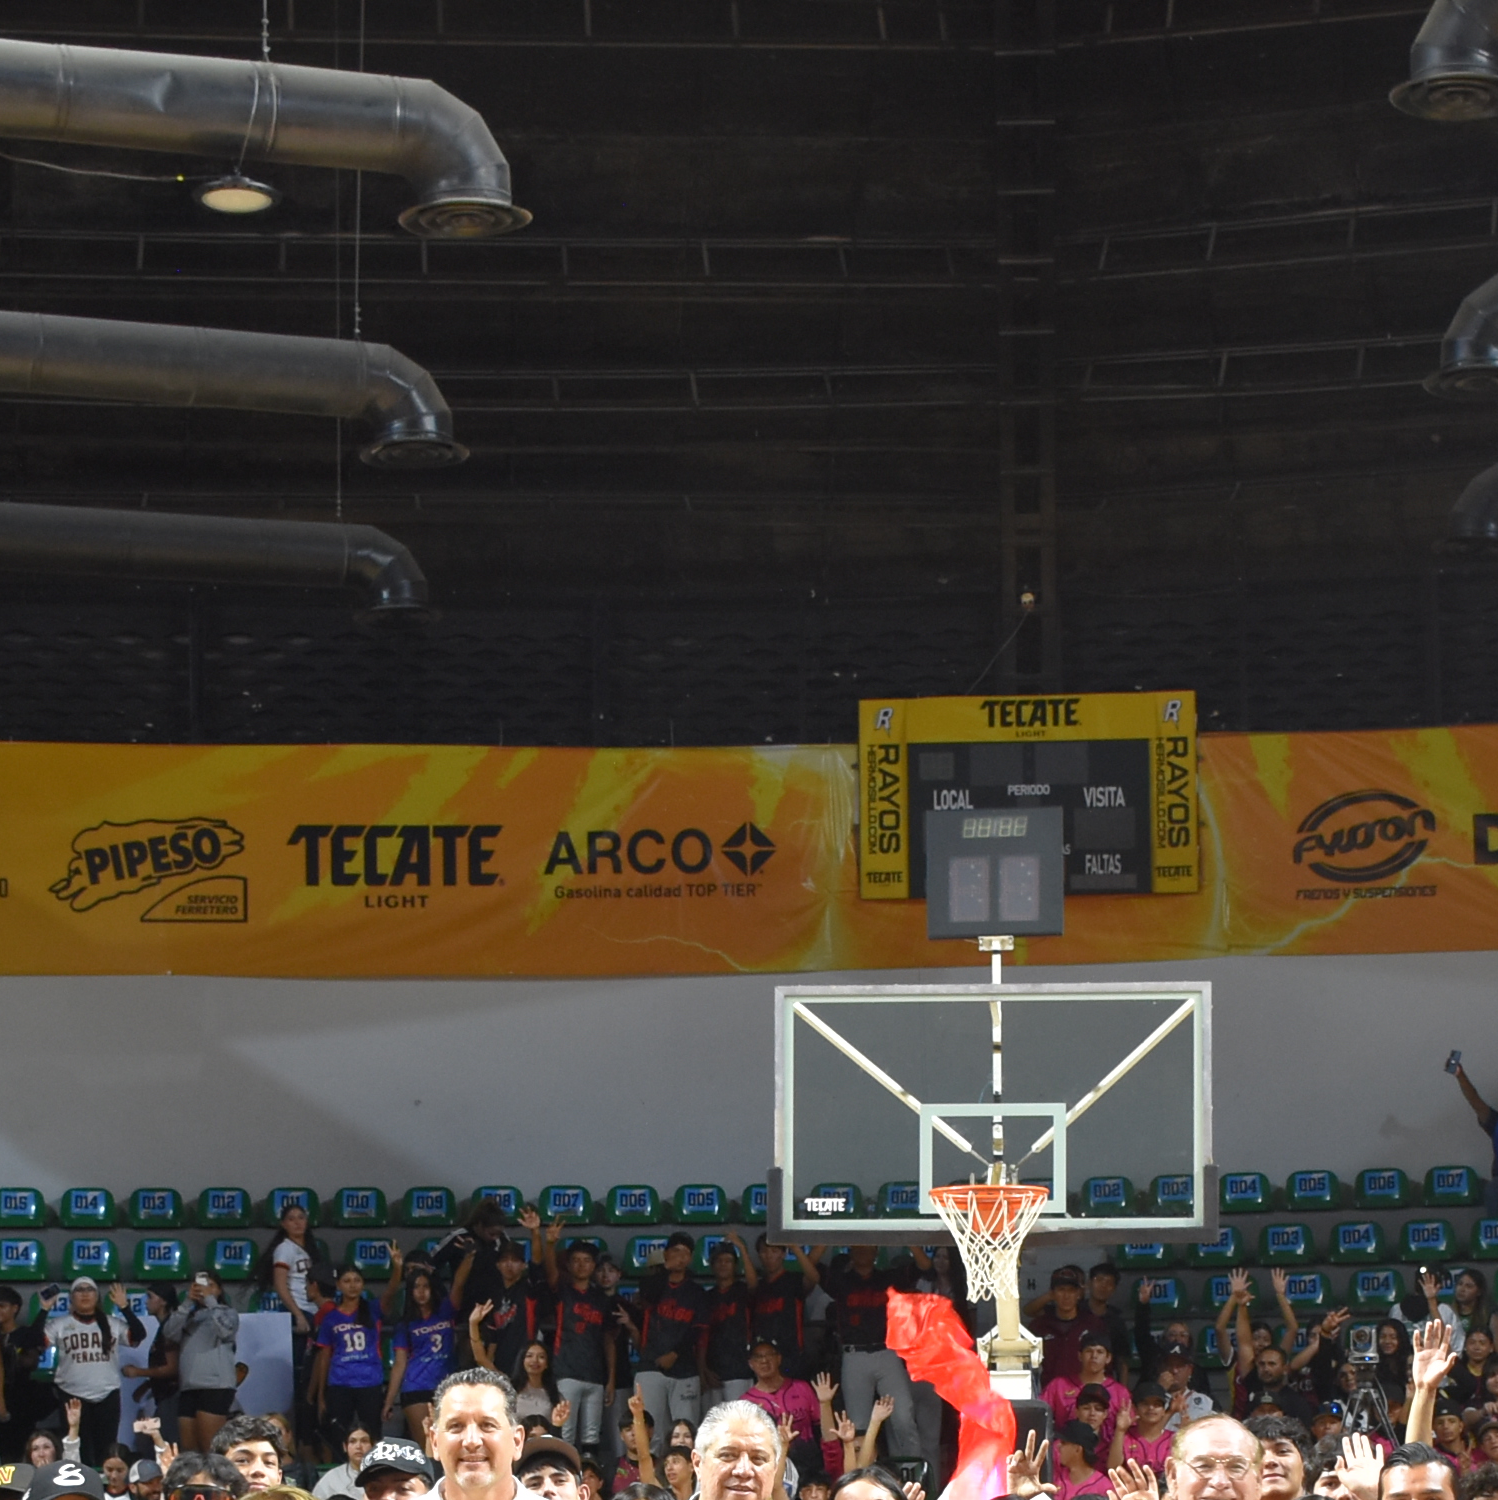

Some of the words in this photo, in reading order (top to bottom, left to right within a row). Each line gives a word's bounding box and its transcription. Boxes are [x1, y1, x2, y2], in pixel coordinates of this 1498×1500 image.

[981, 699, 1080, 727] TECATE
[1008, 784, 1050, 796] PERIODO
[1083, 787, 1125, 808] VISITA
[1166, 736, 1188, 849] RAYOS
[878, 744, 899, 854] RAYOS
[933, 790, 973, 810] LOCAL
[84, 827, 221, 886] PIPESO
[287, 824, 503, 887] TECATE
[544, 828, 712, 875] ARCO
[1086, 854, 1121, 874] FALTAS
[1156, 865, 1192, 877] TECATE
[866, 871, 903, 883] TECATE
[554, 885, 621, 899] Gasolina
[626, 885, 681, 898] calidad
[686, 884, 717, 897] TOP
[187, 895, 238, 905] SERVICIO
[364, 894, 429, 909] LIGHT
[175, 906, 238, 915] FERRETERO
[1230, 1180, 1257, 1194] 004
[1298, 1177, 1326, 1191] 005
[1369, 1175, 1395, 1190] 006
[1437, 1173, 1463, 1187] 007
[891, 1187, 918, 1202] 002
[1094, 1184, 1120, 1198] 002
[1162, 1182, 1189, 1196] 003
[4, 1195, 29, 1210] 015
[74, 1195, 99, 1210] 014
[143, 1195, 166, 1211] 013
[211, 1195, 235, 1210] 012
[346, 1195, 369, 1209] 010
[416, 1195, 443, 1210] 009
[553, 1194, 579, 1208] 007
[620, 1193, 647, 1208] 006
[687, 1193, 714, 1207] 005
[804, 1198, 846, 1212] TECATE
[1271, 1231, 1299, 1246] 003
[1342, 1229, 1370, 1243] 004
[1412, 1227, 1439, 1242] 005
[5, 1245, 31, 1261] 014
[77, 1245, 101, 1261] 013
[147, 1245, 172, 1261] 012
[223, 1245, 243, 1260] 011
[1362, 1278, 1389, 1292] 004
[344, 1332, 366, 1353] 18
[431, 1334, 443, 1352] 3
